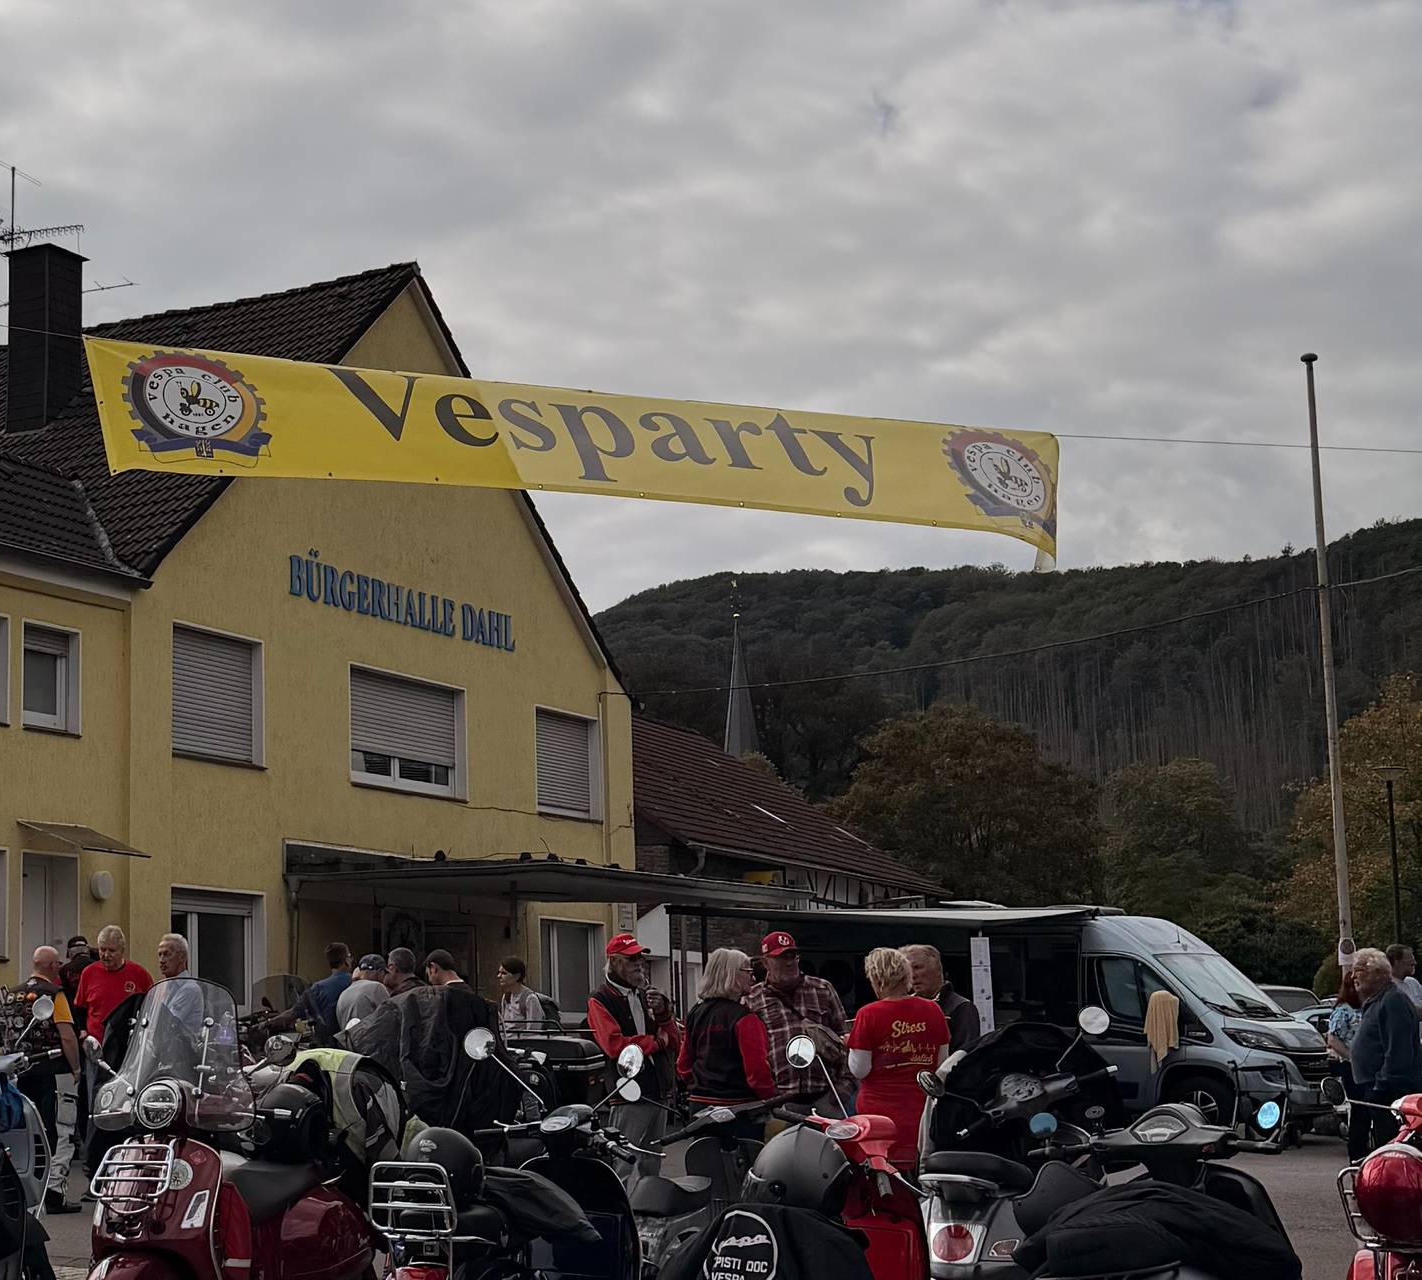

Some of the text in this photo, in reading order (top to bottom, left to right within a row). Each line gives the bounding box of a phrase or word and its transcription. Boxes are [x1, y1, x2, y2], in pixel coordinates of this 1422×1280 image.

[147, 367, 241, 404] vespa club
[162, 412, 236, 436] hagen
[324, 365, 876, 508] Vesparty
[289, 547, 516, 652] BÜRGERHALLE DAHL
[891, 1020, 927, 1038] Stress
[746, 1261, 769, 1273] DOC
